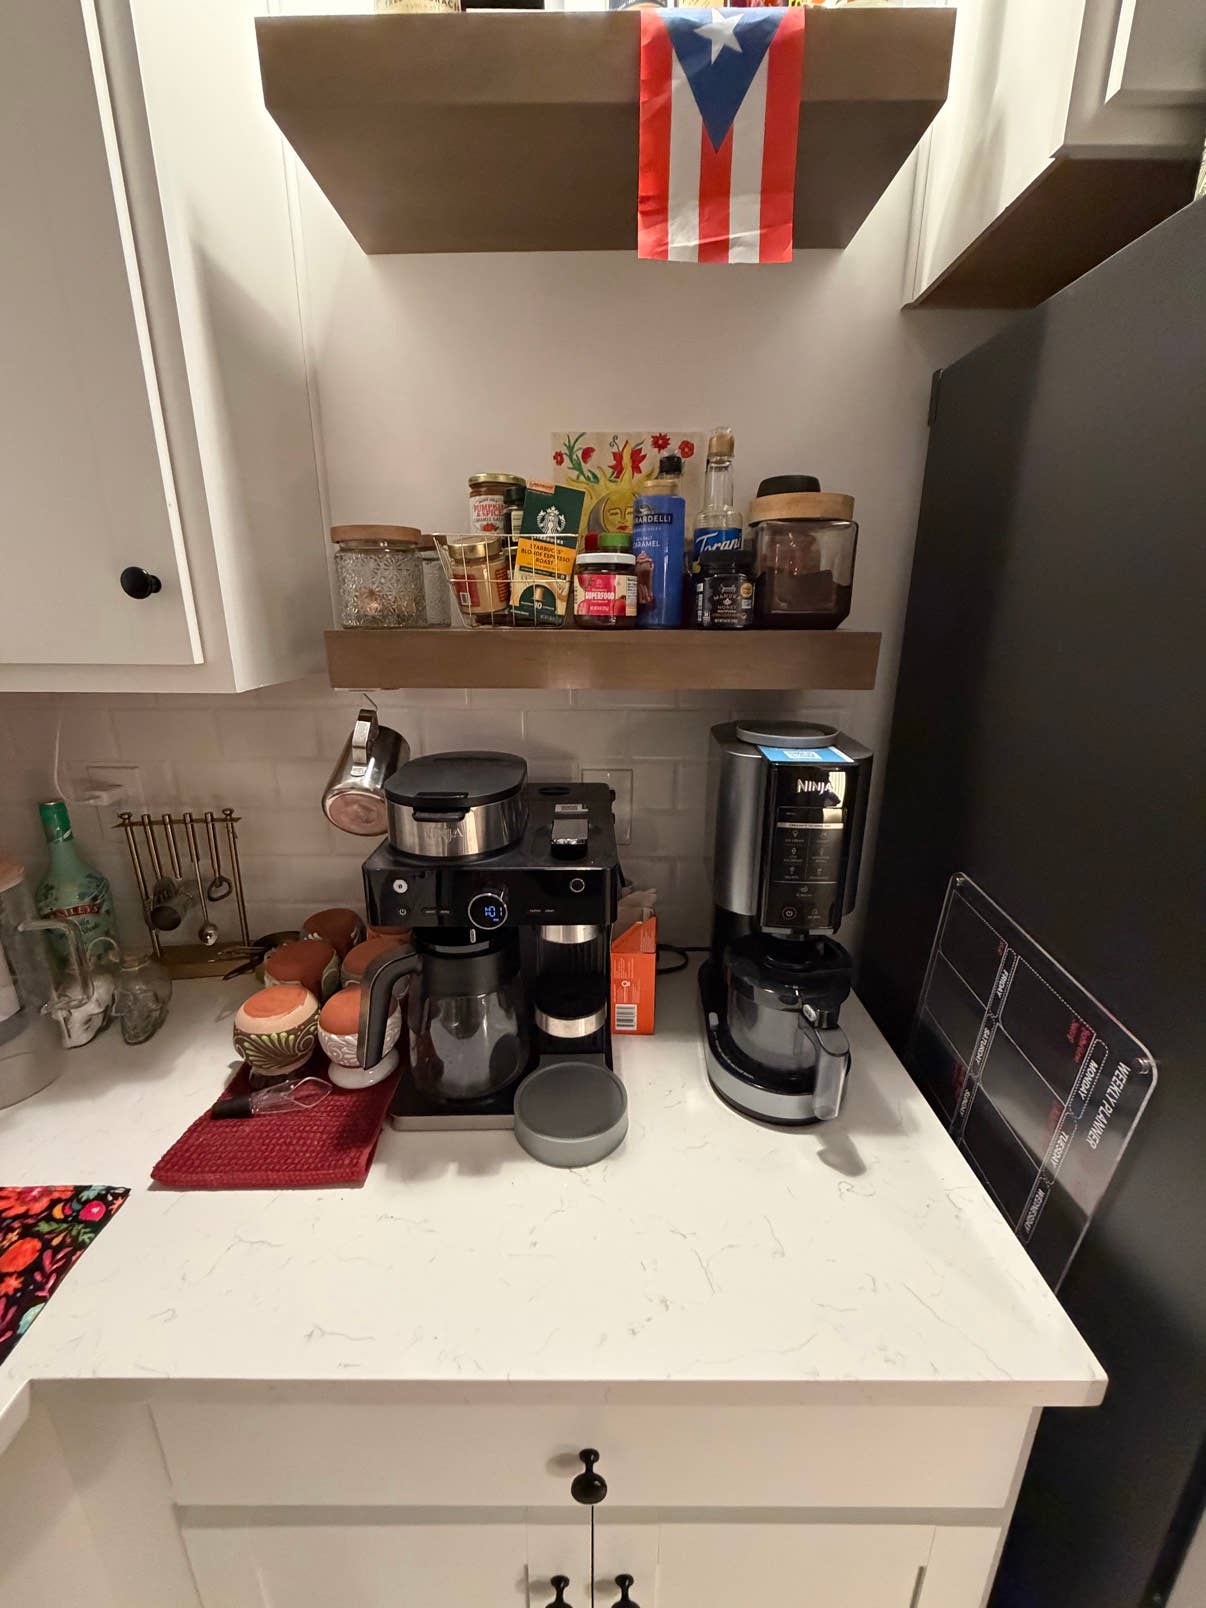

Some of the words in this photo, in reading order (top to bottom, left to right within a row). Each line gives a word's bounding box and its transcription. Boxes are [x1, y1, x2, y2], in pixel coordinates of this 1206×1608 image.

[635, 514, 671, 523] RARDELLI
[530, 543, 563, 555] STARBUCS
[544, 553, 570, 563] ESPRSSO
[585, 591, 615, 600] SUPERFOOD
[797, 778, 833, 794] NINJA
[996, 969, 1009, 998] FRIDAY
[975, 1027, 991, 1065] SATURDAY
[1078, 1060, 1098, 1101] MONDAY
[1104, 1062, 1131, 1107] WEEKLY
[1086, 1099, 1114, 1150] PLANNER
[1050, 1131, 1069, 1168] TUESDAY
[1024, 1188, 1046, 1233] WEDNESDAY
